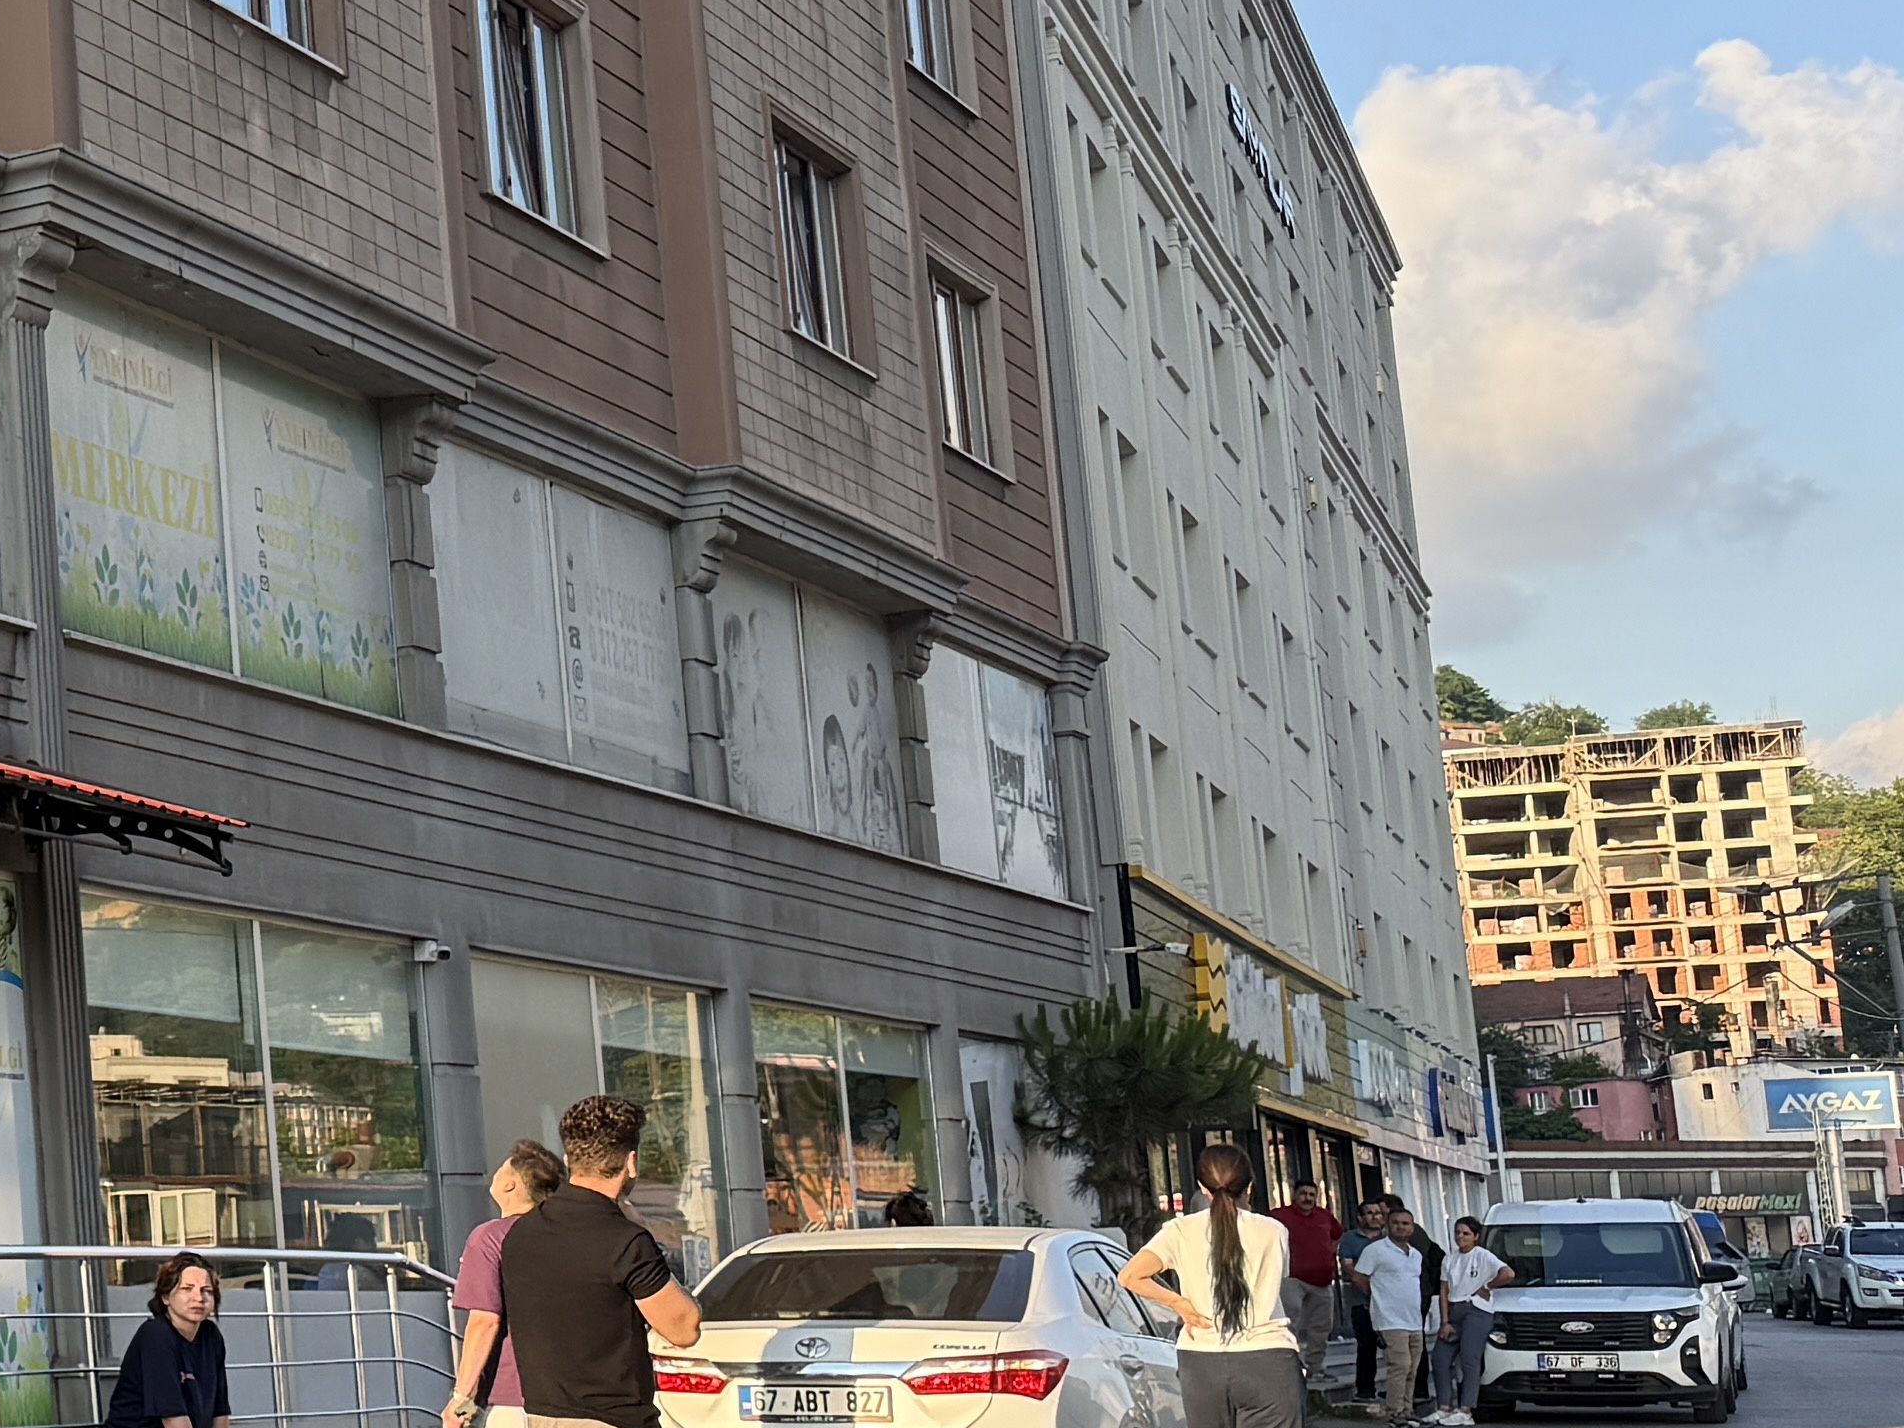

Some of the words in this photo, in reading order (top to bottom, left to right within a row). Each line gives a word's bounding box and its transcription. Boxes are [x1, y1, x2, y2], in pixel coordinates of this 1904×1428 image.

[51, 429, 217, 540] MERKEZİ
[1779, 1089, 1883, 1115] AYGAZ
[1546, 1356, 1559, 1367] 67
[1596, 1356, 1617, 1367] 336
[754, 1390, 776, 1415] 67
[794, 1390, 830, 1414] ABT
[847, 1390, 885, 1413] 827
